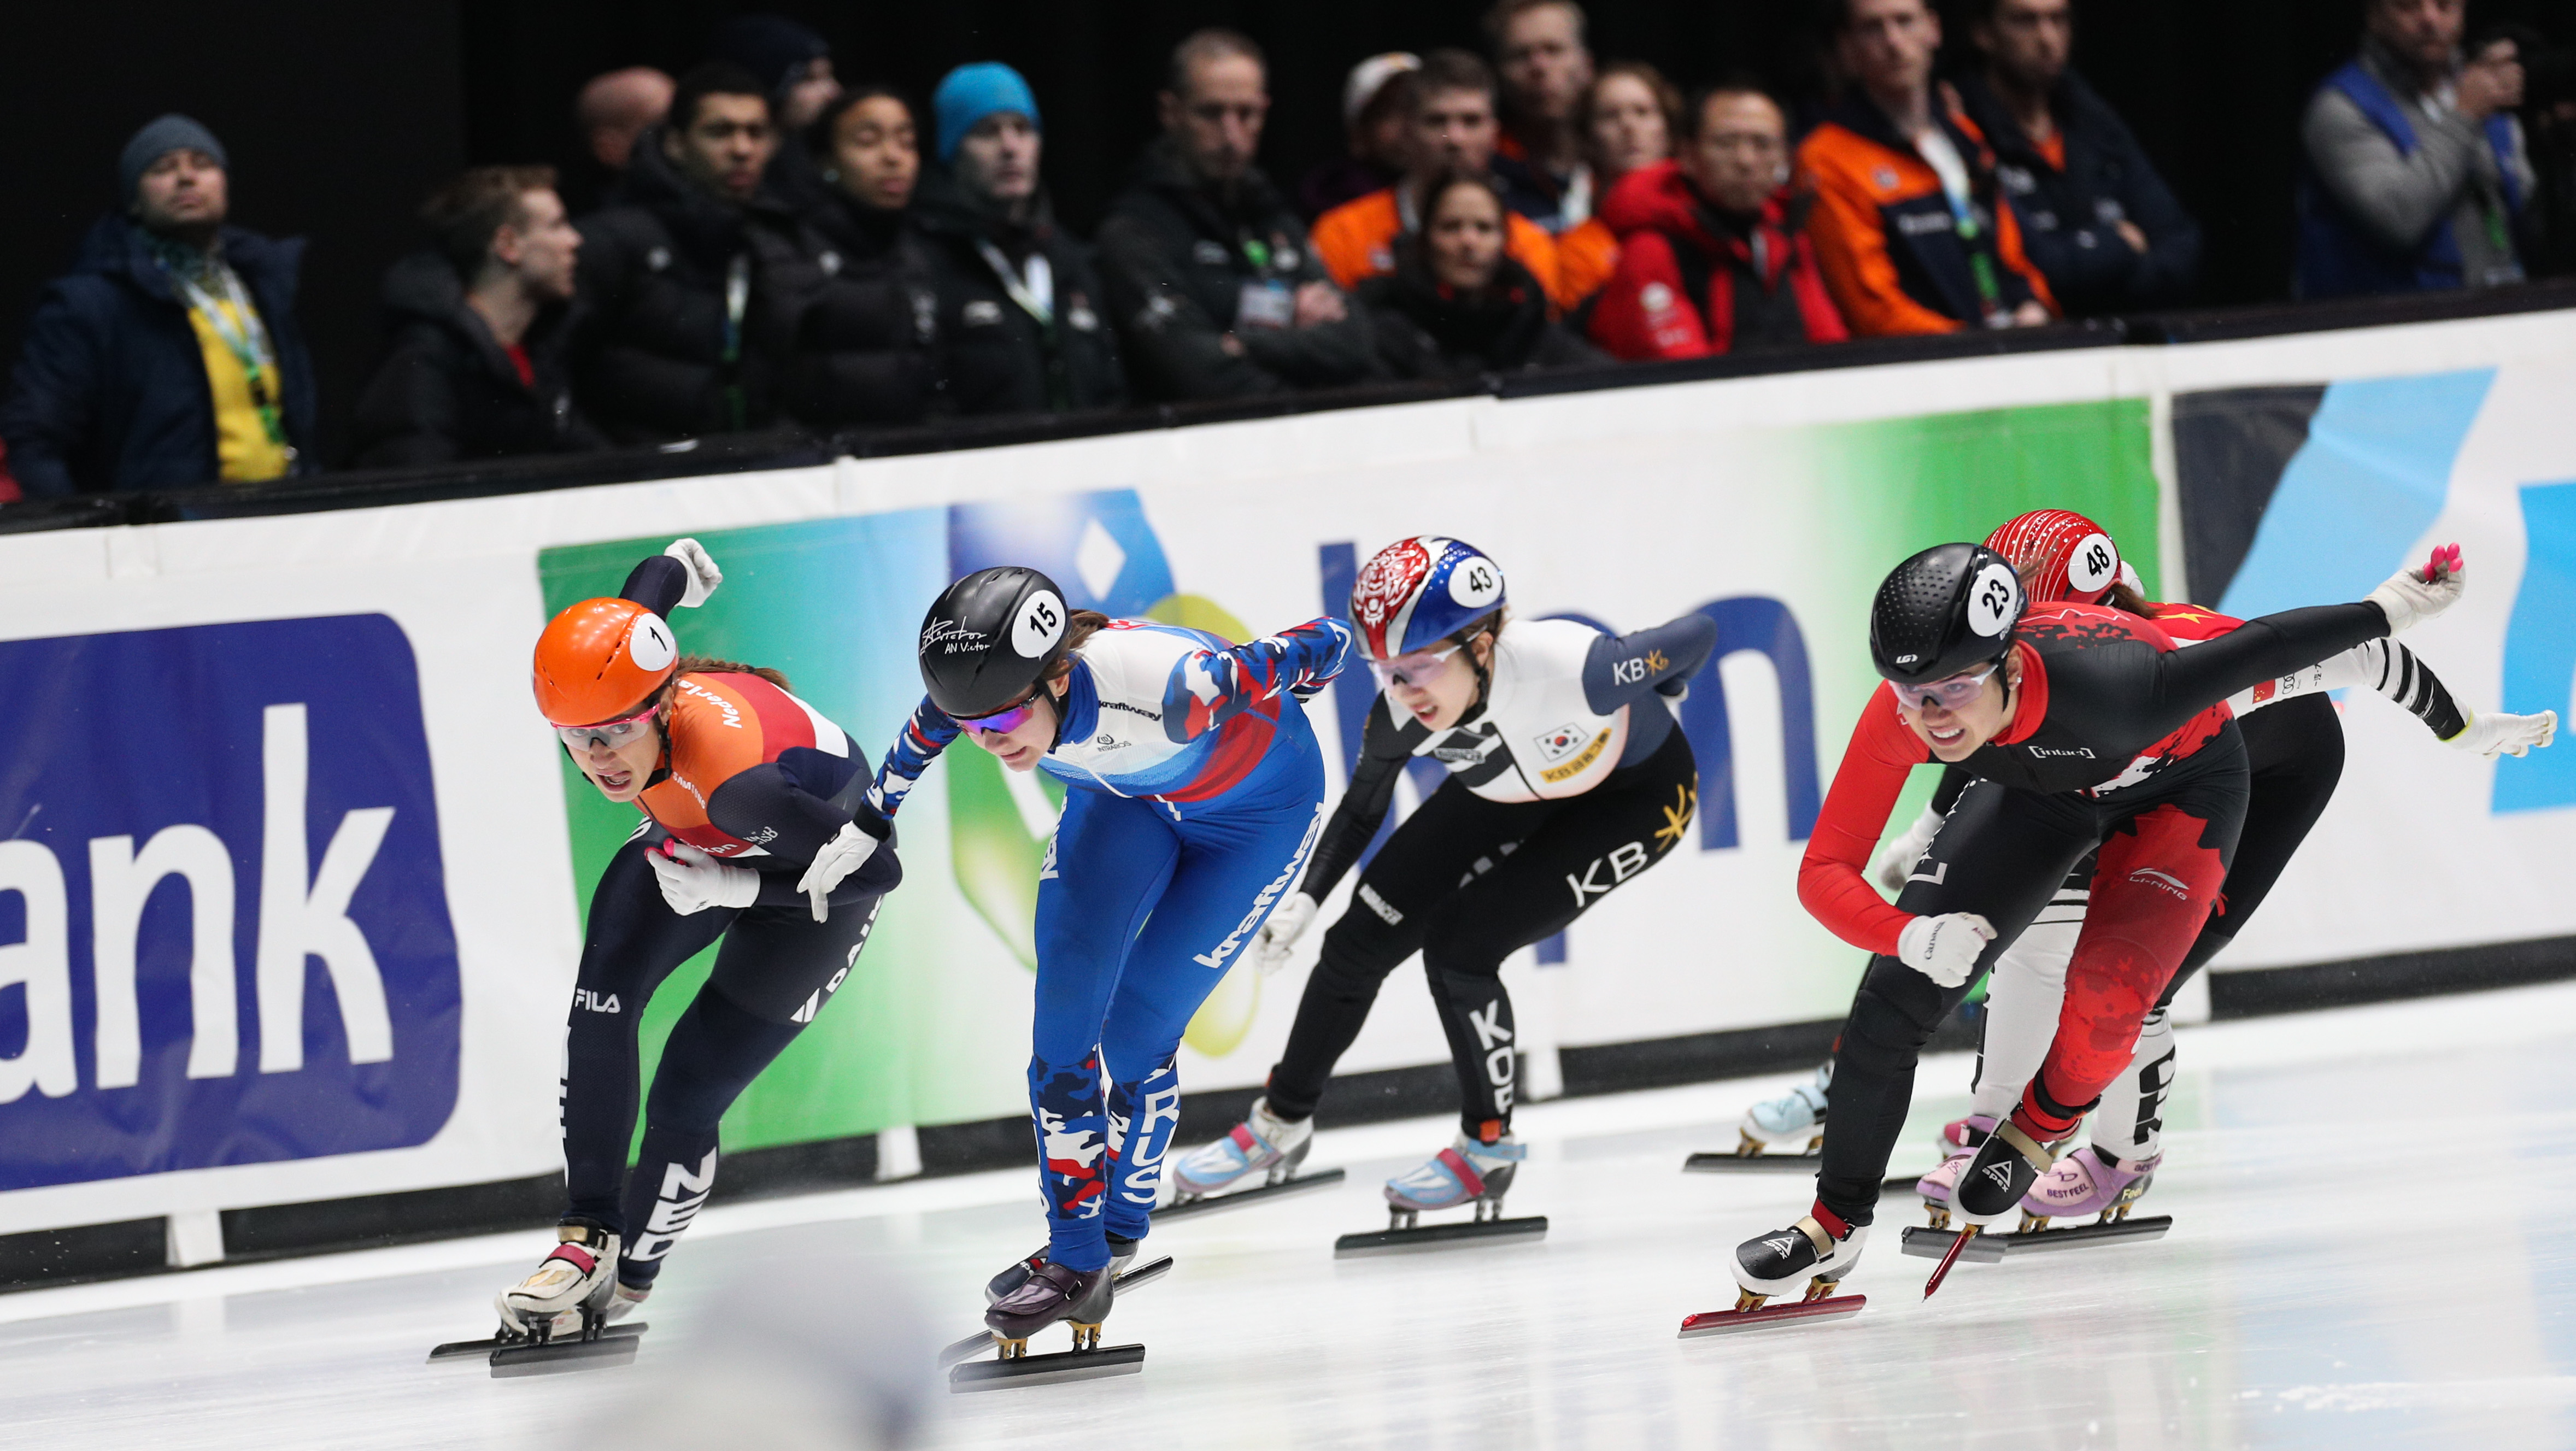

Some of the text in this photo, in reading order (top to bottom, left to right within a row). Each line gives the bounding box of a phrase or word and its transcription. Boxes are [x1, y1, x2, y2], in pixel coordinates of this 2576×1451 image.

[2088, 543, 2110, 578] 48
[1469, 567, 1493, 593] 43
[1982, 579, 2010, 620] 23
[1030, 602, 1057, 638] 15
[649, 626, 667, 651] 1
[944, 641, 991, 655] AN Victor
[1613, 657, 1646, 686] KB
[1099, 700, 1163, 721] kraftway
[1566, 841, 1648, 907] KB
[2128, 876, 2187, 901] LI-NING
[575, 988, 621, 1014] FILA
[1120, 1084, 1181, 1204] RUS
[1981, 1167, 2009, 1193] apex
[2046, 1183, 2090, 1199] BEST FEEL
[629, 1145, 718, 1262] NED
[1761, 1241, 1788, 1260] apex
